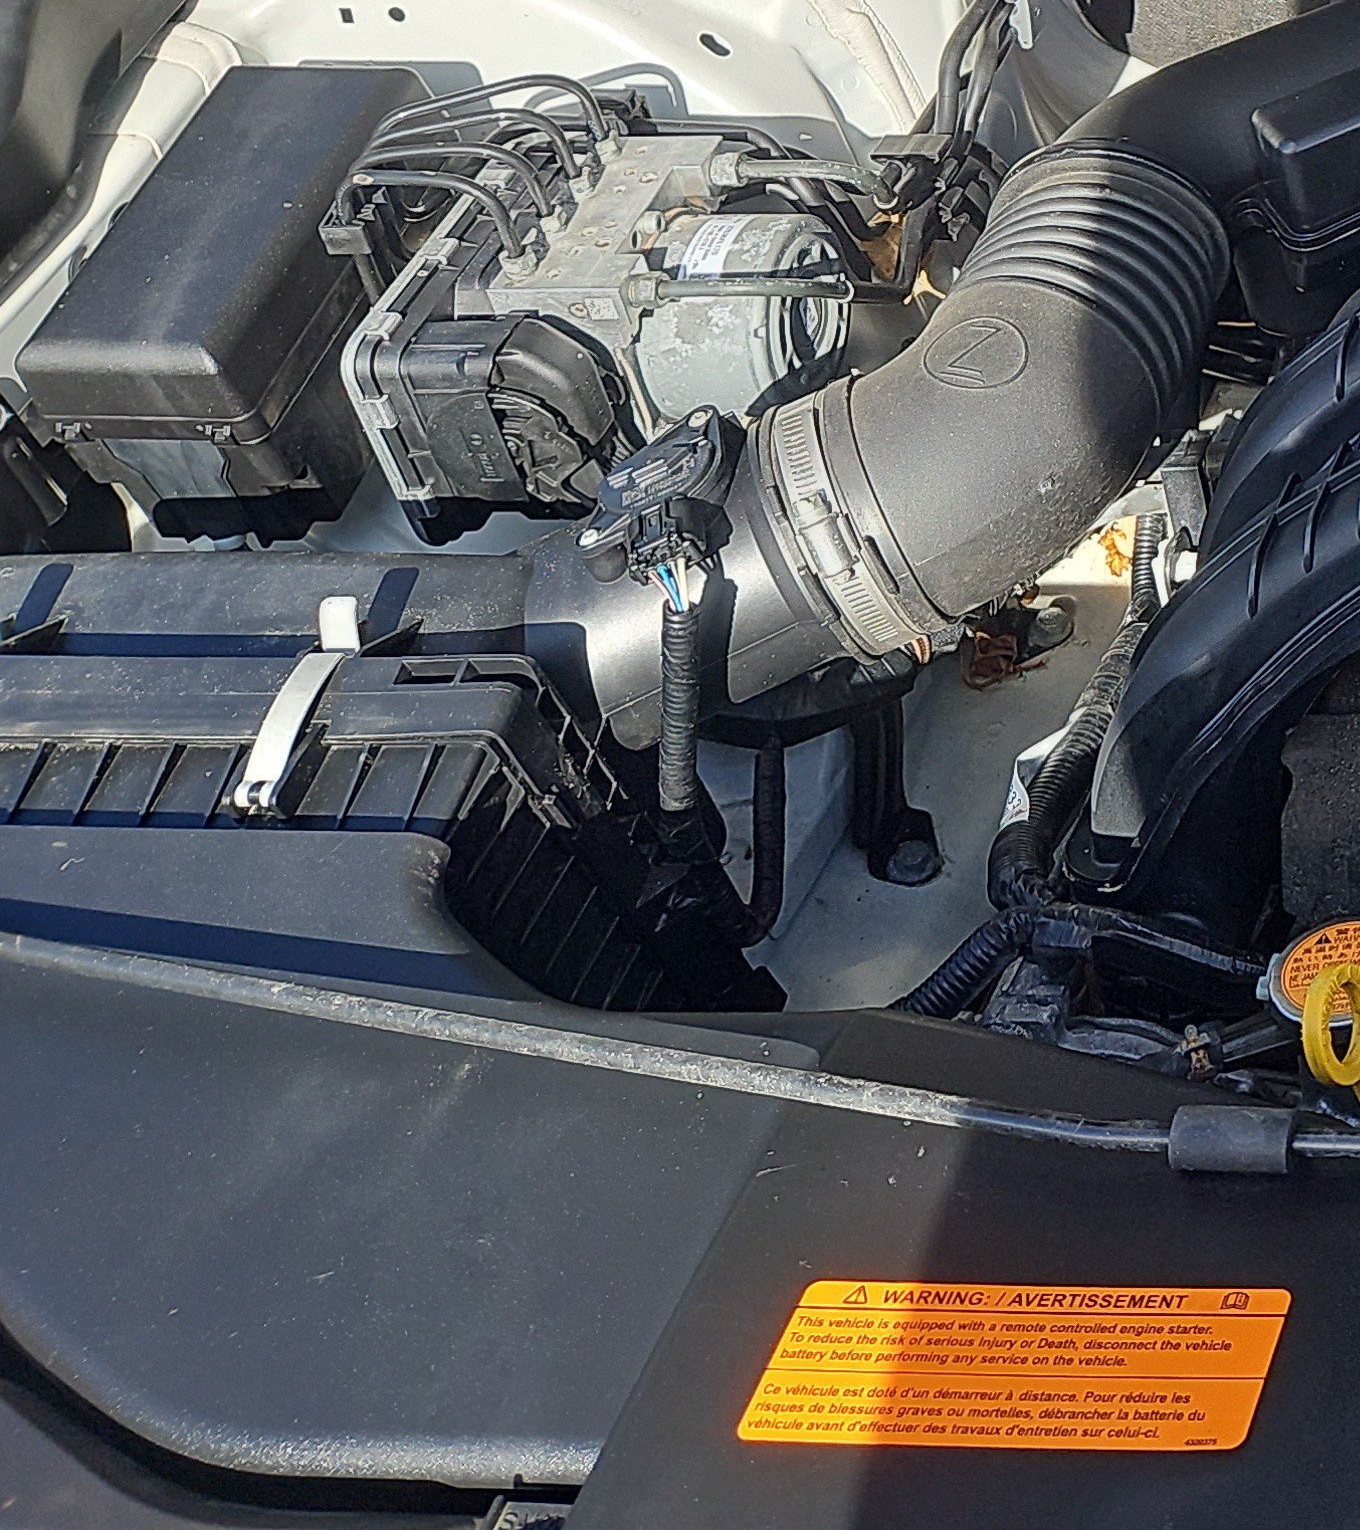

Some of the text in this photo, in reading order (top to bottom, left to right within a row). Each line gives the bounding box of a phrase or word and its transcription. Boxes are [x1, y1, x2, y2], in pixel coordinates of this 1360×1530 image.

[883, 1290, 1189, 1309] WARNING: / AVERTISSEMENT
[797, 1316, 1214, 1337] This vehicle is equipped with a remote controlled engine starter.
[789, 1332, 804, 1343] To
[806, 1332, 853, 1344] reduce
[856, 1332, 878, 1344] the
[880, 1334, 909, 1346] risk
[909, 1336, 926, 1346] of
[926, 1336, 975, 1347] serious
[1020, 1340, 1036, 1348] or
[1037, 1338, 1078, 1351] Death,
[1083, 1338, 1158, 1350] disconnect
[1160, 1339, 1182, 1350] the
[1185, 1340, 1232, 1351] vehicle
[780, 1348, 1128, 1366] battery before performing any service on the vehicle.
[763, 1382, 1191, 1404] Ce véhicule est doté d'un démarreur à distance. Pour réduire les
[754, 1402, 1206, 1421] risques de blessures graves ou mortelles, débrancher la batterie du
[747, 1418, 802, 1430] véhicule
[806, 1422, 845, 1432] avant
[847, 1420, 920, 1433] d'effectuer
[922, 1422, 946, 1434] des
[951, 1424, 1002, 1435] travaux
[1004, 1424, 1078, 1437] d'entretien
[1080, 1428, 1104, 1438] sur
